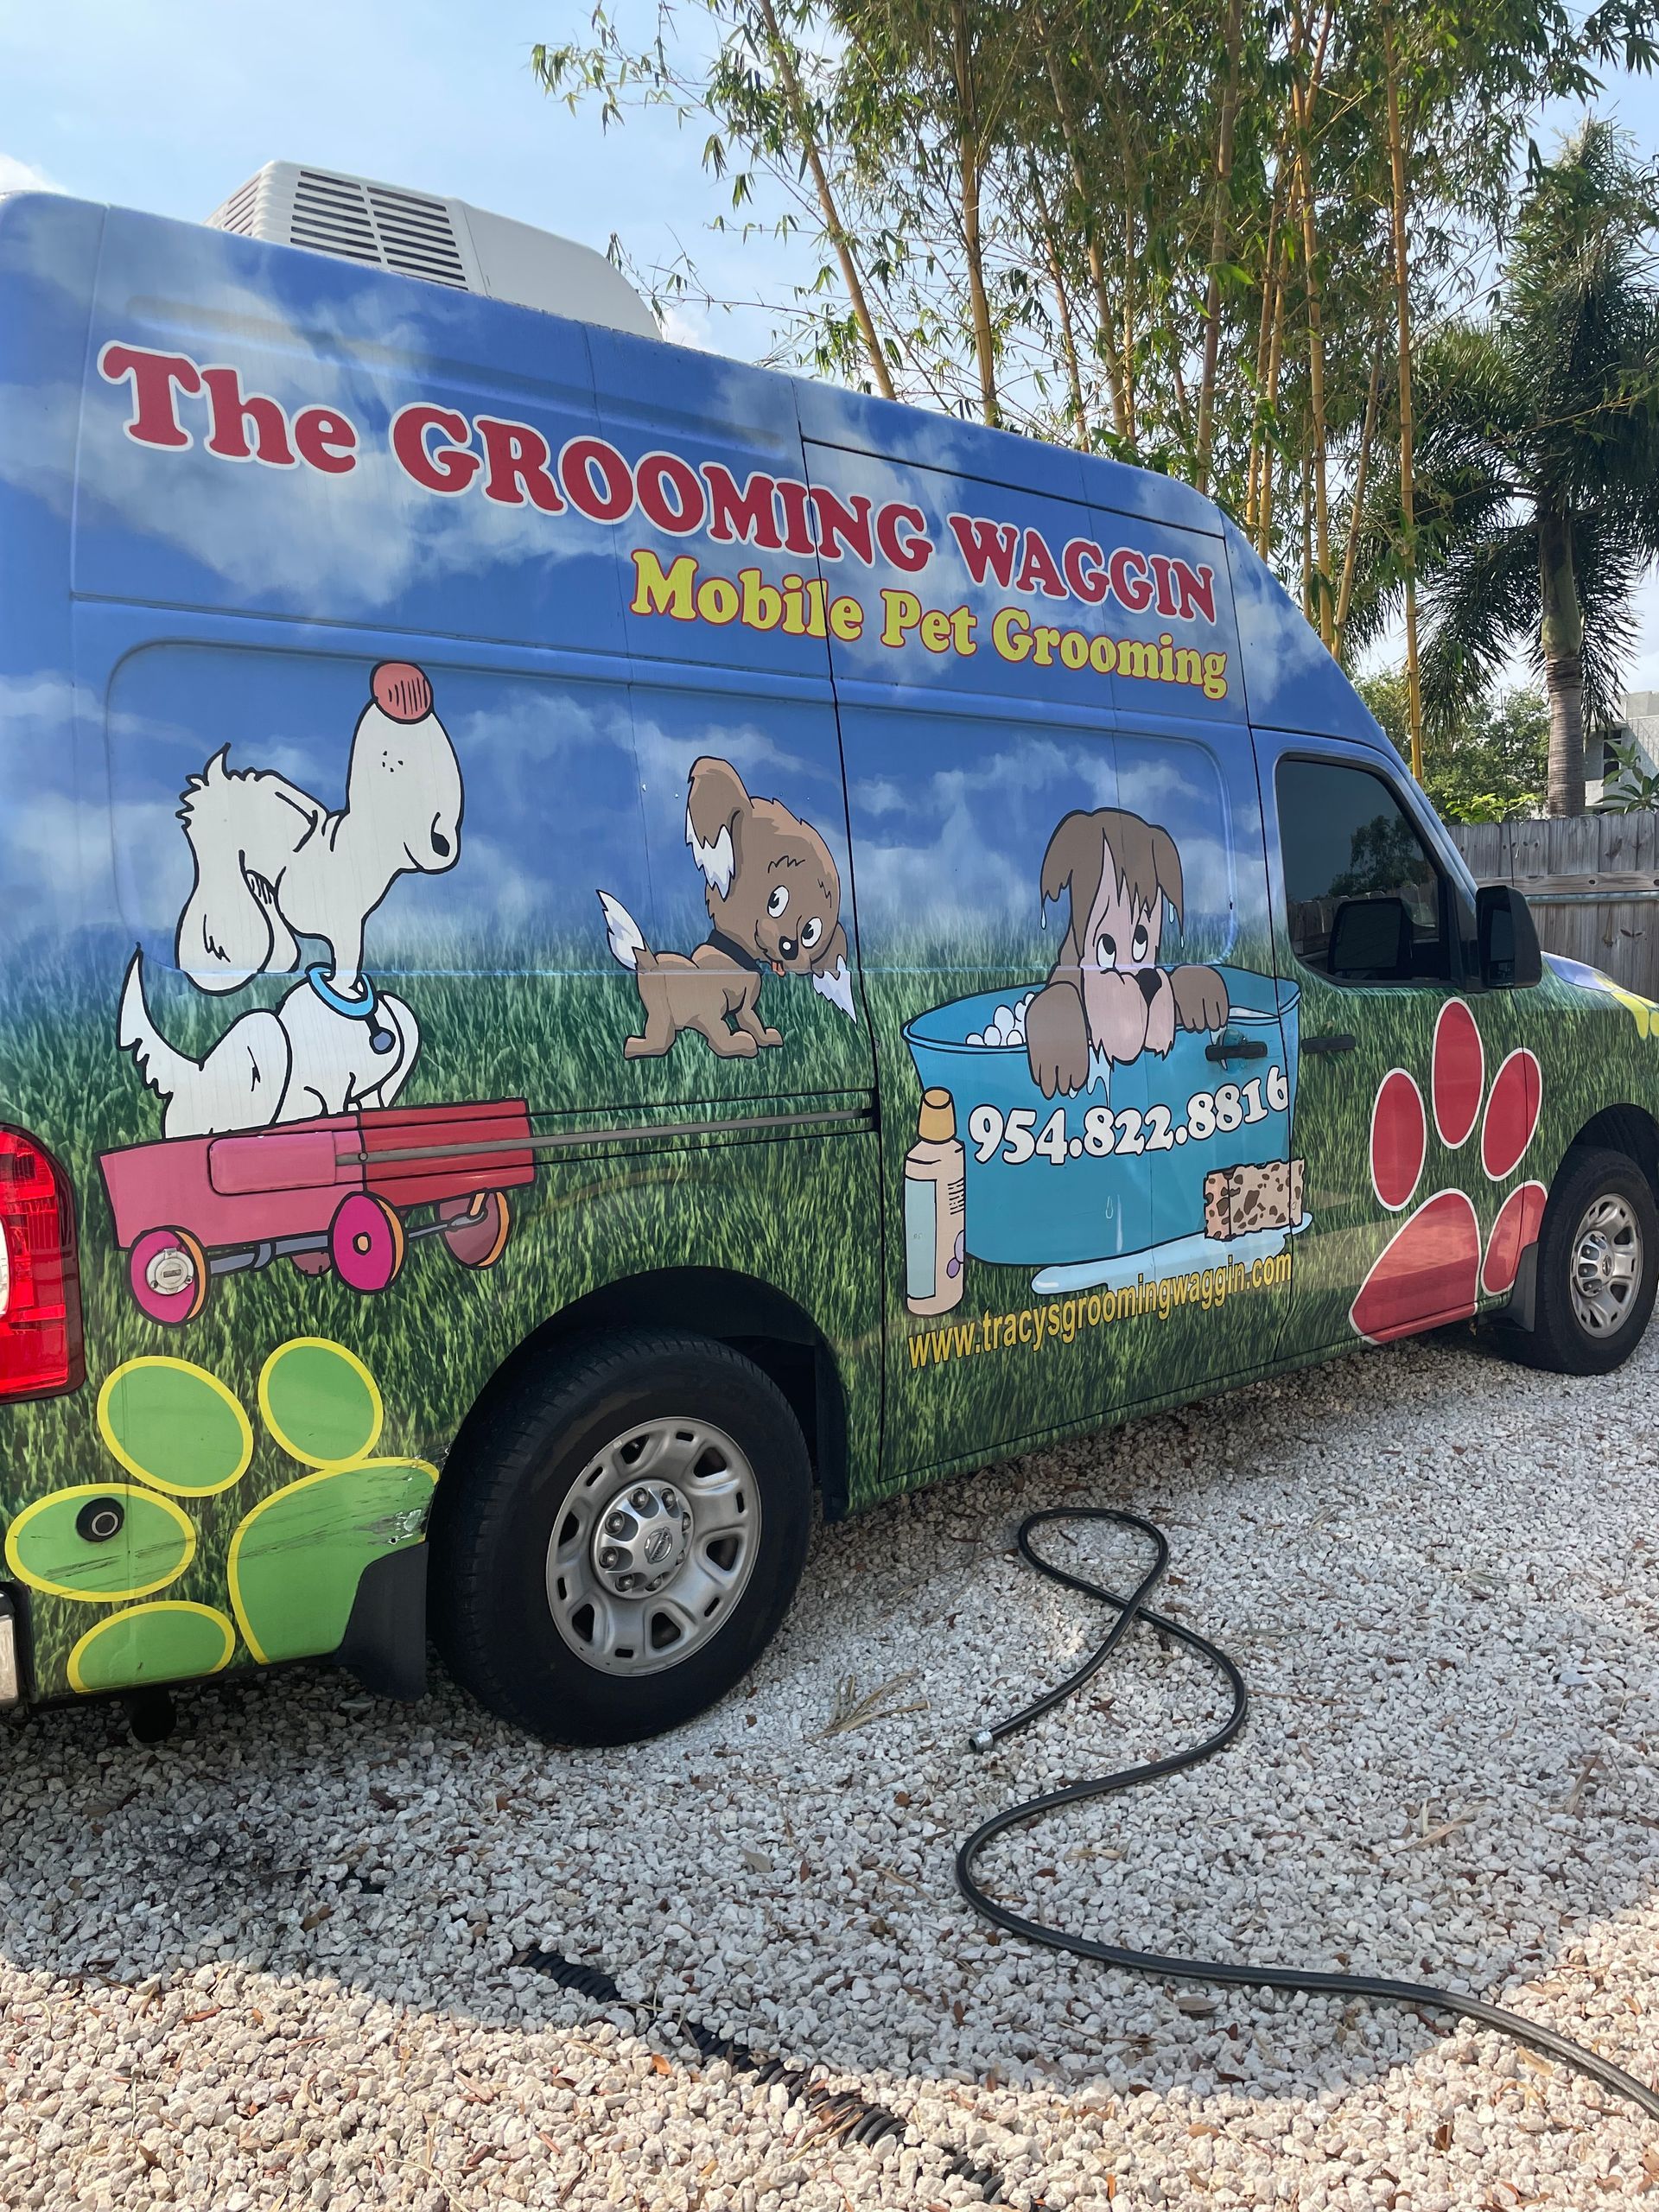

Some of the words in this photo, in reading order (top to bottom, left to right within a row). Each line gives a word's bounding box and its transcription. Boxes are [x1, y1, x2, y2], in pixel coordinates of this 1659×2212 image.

[99, 340, 358, 474] The
[391, 402, 934, 574] GROOMING
[948, 512, 1217, 626] WAGGIN
[631, 549, 864, 641] Mobile
[880, 588, 977, 656] Pet
[992, 607, 1227, 699] Grooming
[968, 1065, 1290, 1165] 954.822.8816
[908, 1251, 1293, 1370] www.tracysgroomingwaggin.com
